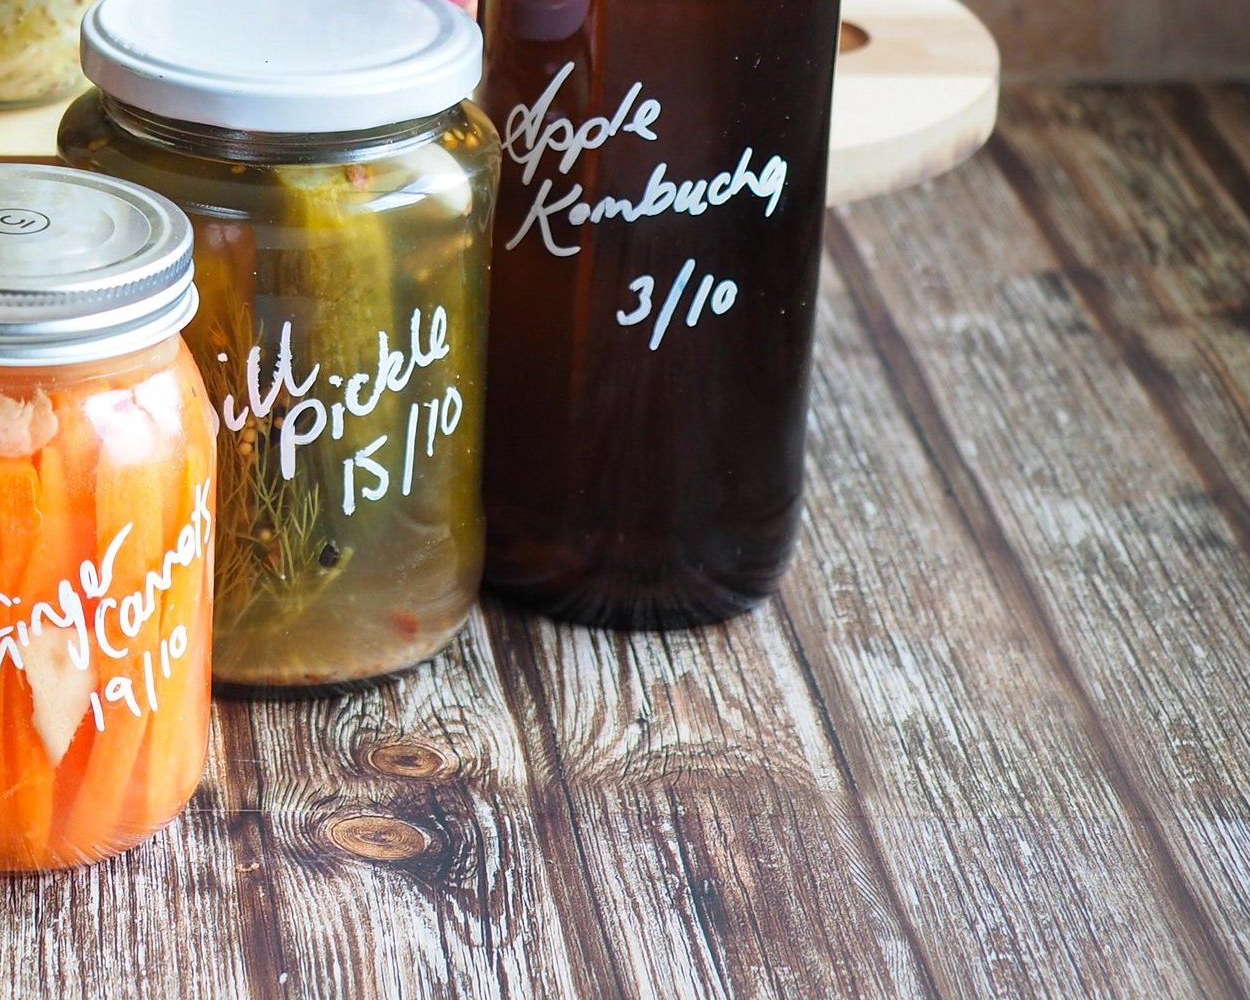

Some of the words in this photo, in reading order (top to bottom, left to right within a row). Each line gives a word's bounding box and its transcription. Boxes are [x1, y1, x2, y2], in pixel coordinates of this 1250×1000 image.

[501, 61, 662, 185] Apple
[505, 147, 788, 257] Kombucha
[616, 258, 739, 351] 3/10
[215, 321, 320, 432] ill
[343, 386, 463, 516] 15/10
[90, 623, 188, 732] 19/10
